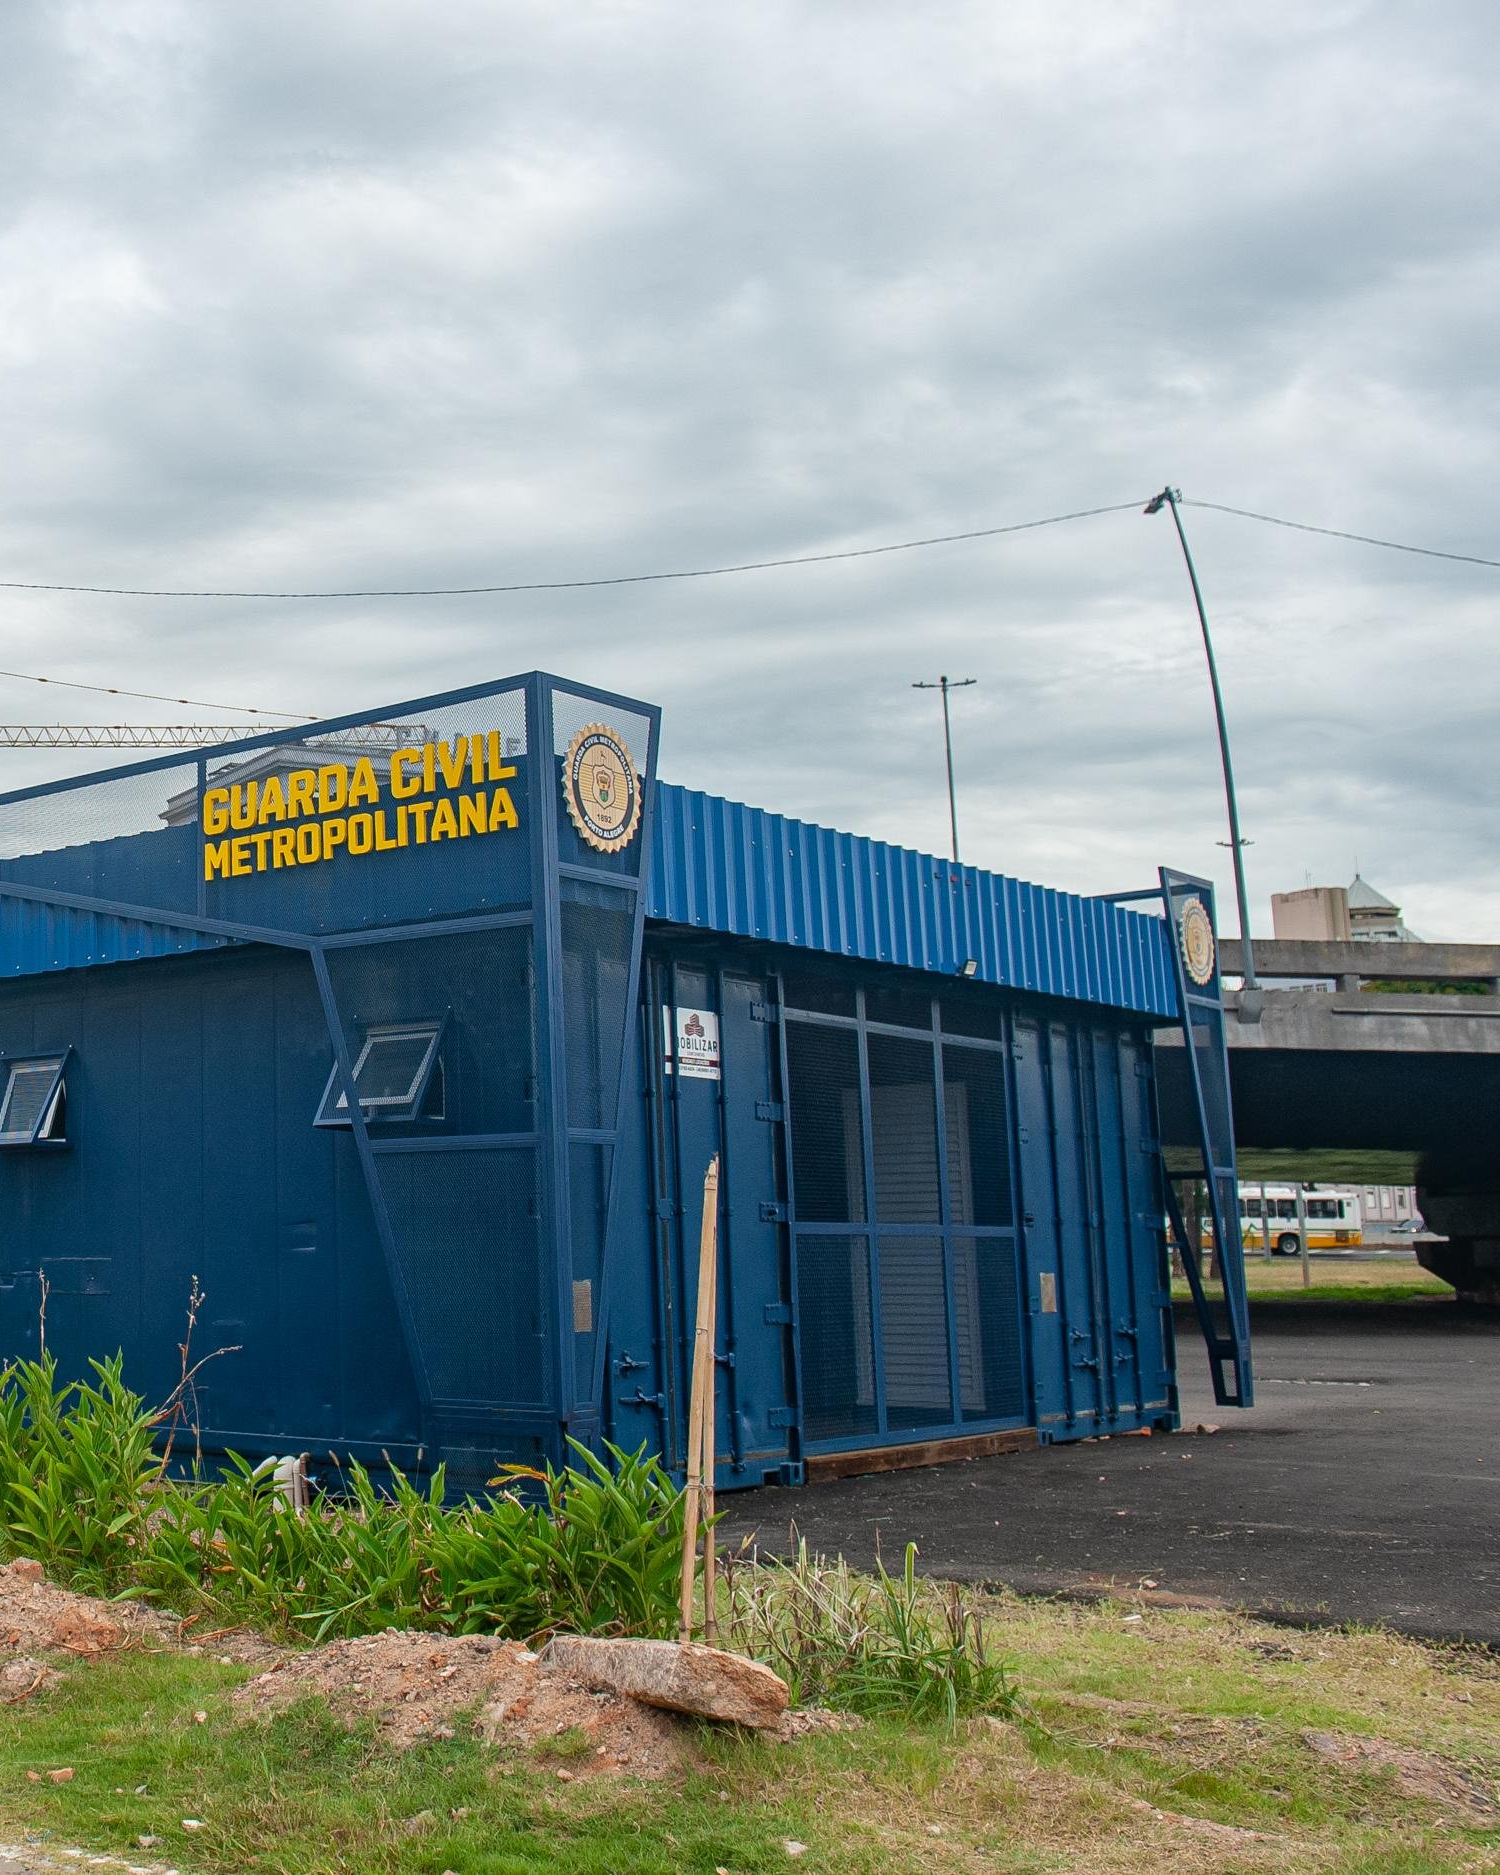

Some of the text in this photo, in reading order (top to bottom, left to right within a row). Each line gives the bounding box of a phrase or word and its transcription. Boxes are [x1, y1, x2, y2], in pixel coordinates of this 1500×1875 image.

[584, 735, 599, 748] CIVIL
[203, 730, 517, 836] GUARDA CIVIL
[204, 788, 518, 881] METROPOLITANA
[584, 815, 625, 839] PORTO ALEGRE
[678, 1037, 718, 1053] OBILIZAR
